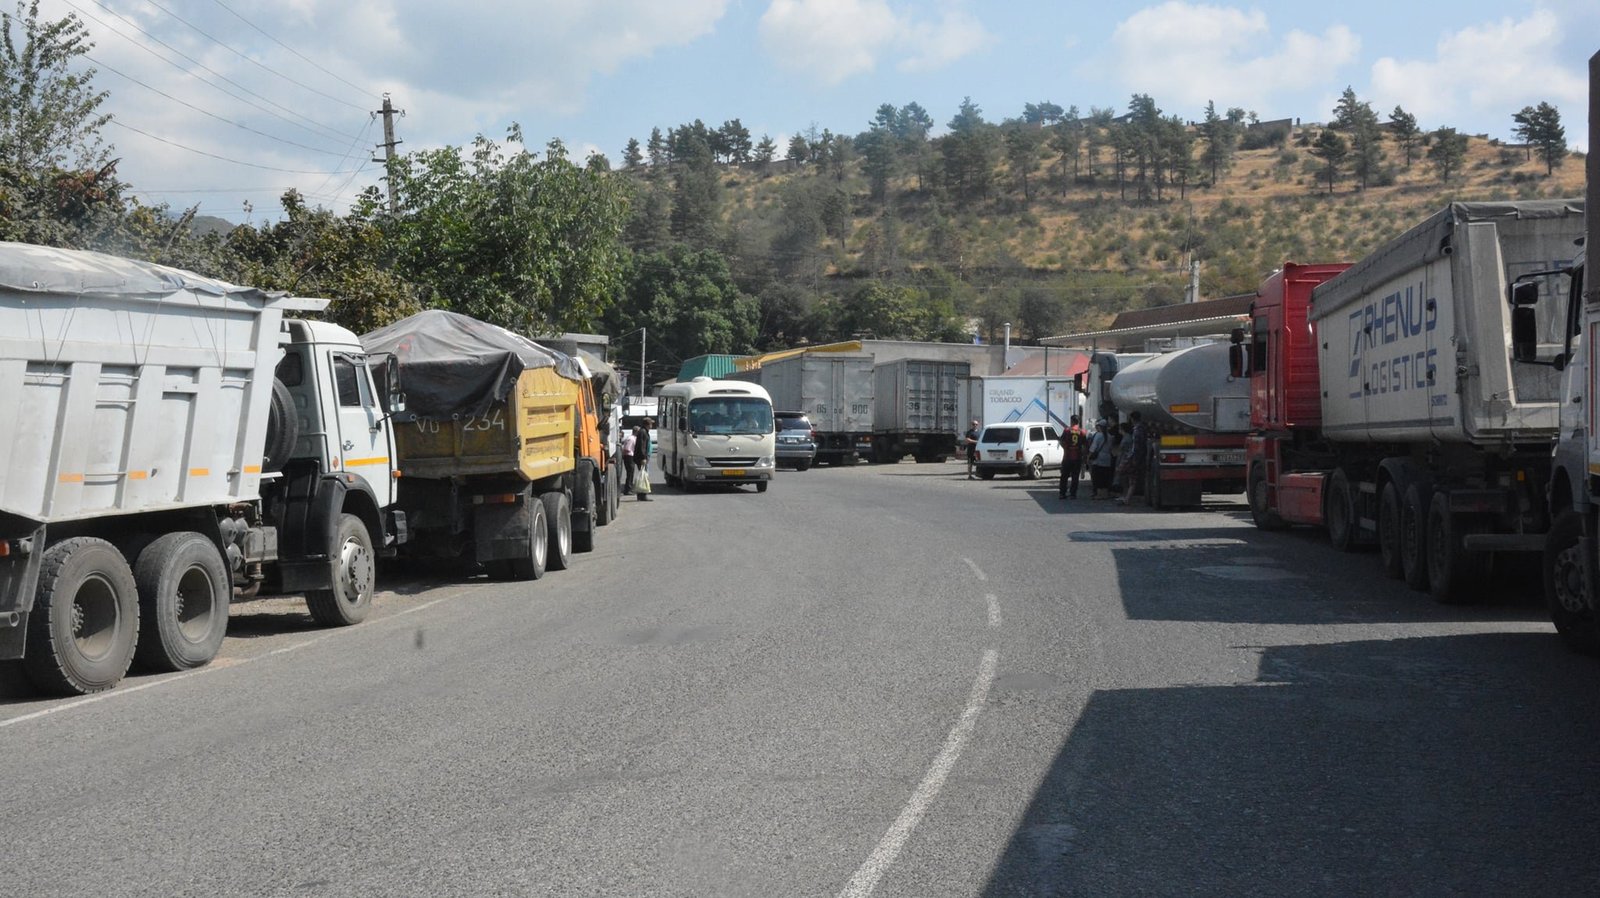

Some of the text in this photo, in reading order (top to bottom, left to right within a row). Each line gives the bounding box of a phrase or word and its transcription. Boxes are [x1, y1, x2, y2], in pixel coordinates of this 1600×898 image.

[1364, 281, 1437, 351] RHENUS
[1364, 348, 1437, 396] LOGISTICS
[1072, 434, 1079, 446] 9
